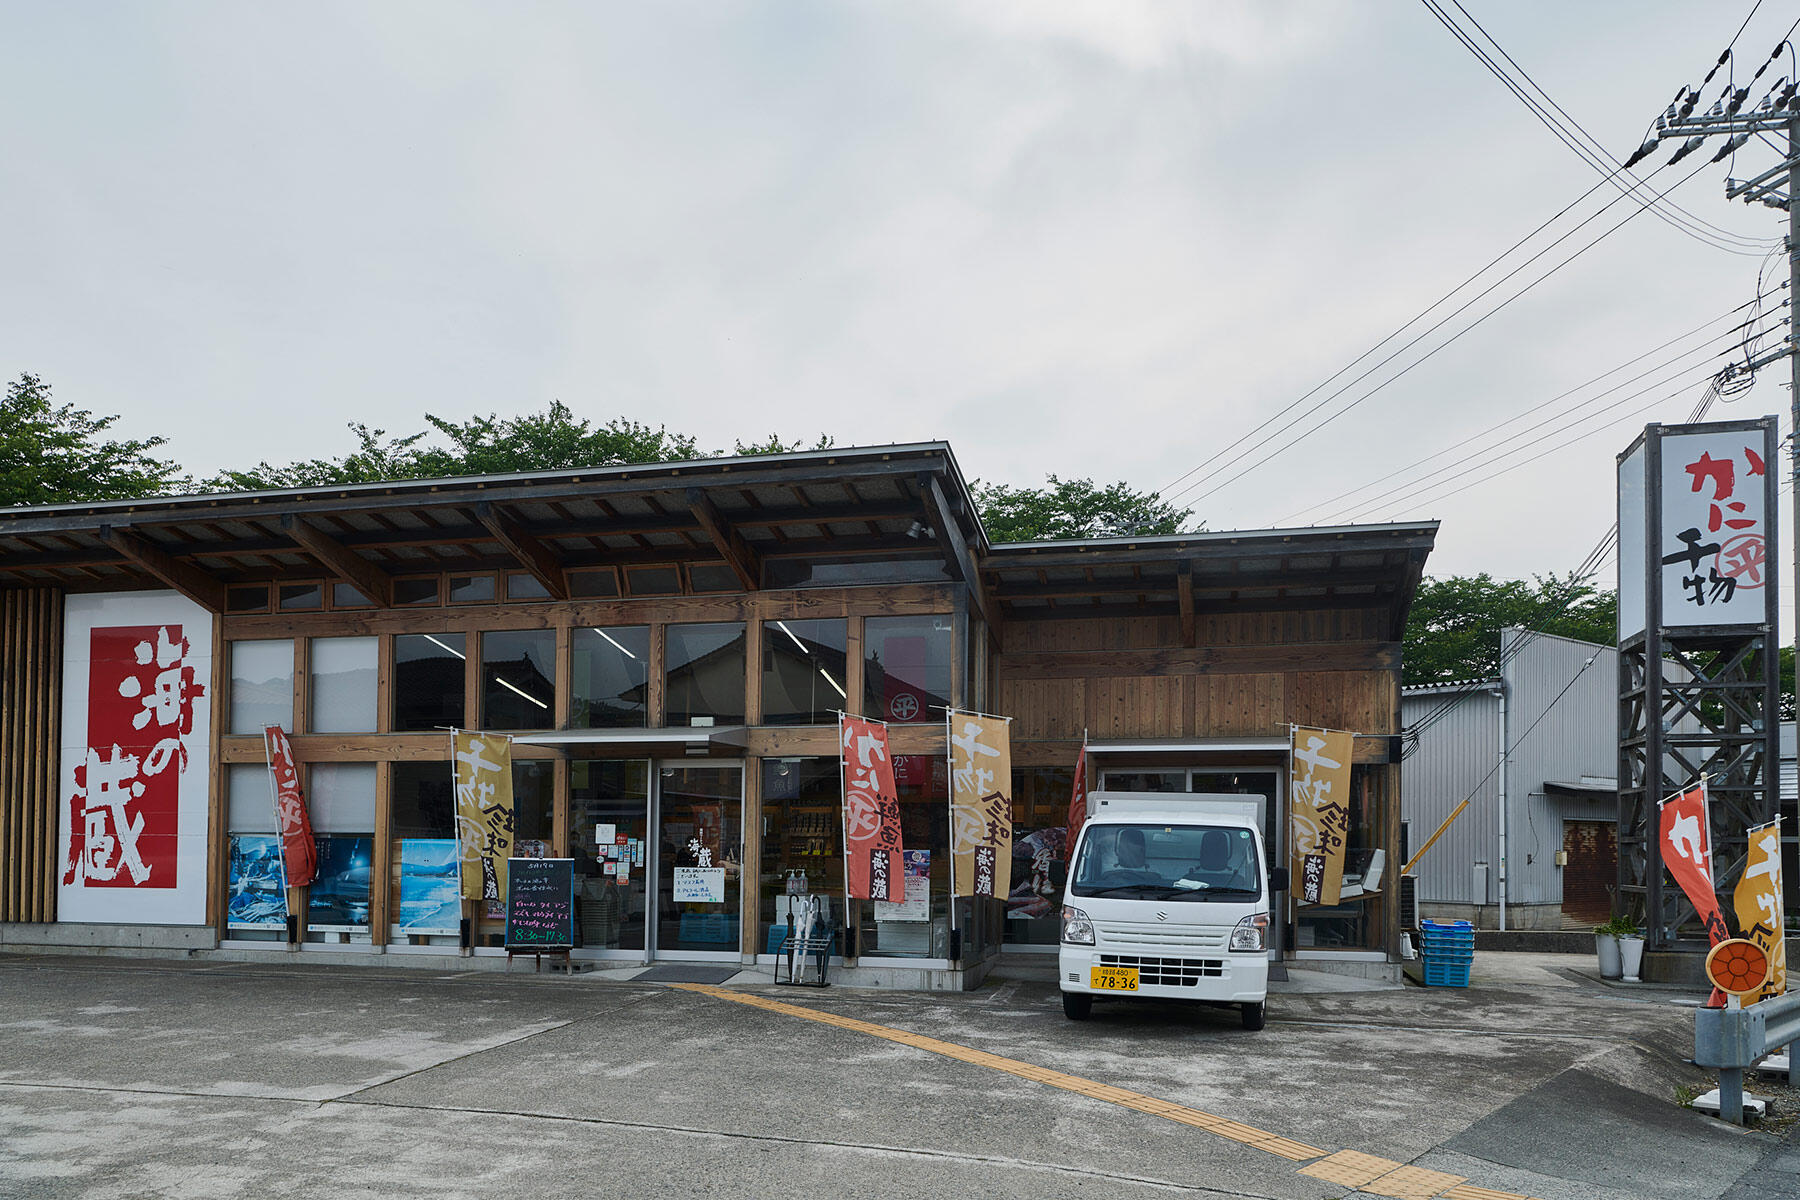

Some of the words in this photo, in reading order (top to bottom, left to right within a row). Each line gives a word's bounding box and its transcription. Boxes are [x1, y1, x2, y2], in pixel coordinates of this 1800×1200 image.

[1685, 446, 1765, 532] かに
[1662, 528, 1737, 607] 干物
[1723, 538, 1765, 583] 平
[893, 696, 916, 718] 平
[62, 625, 207, 886] 海の蔵
[894, 755, 909, 779] かに
[687, 837, 713, 868] 海の蔵
[1100, 975, 1136, 990] 78-36
